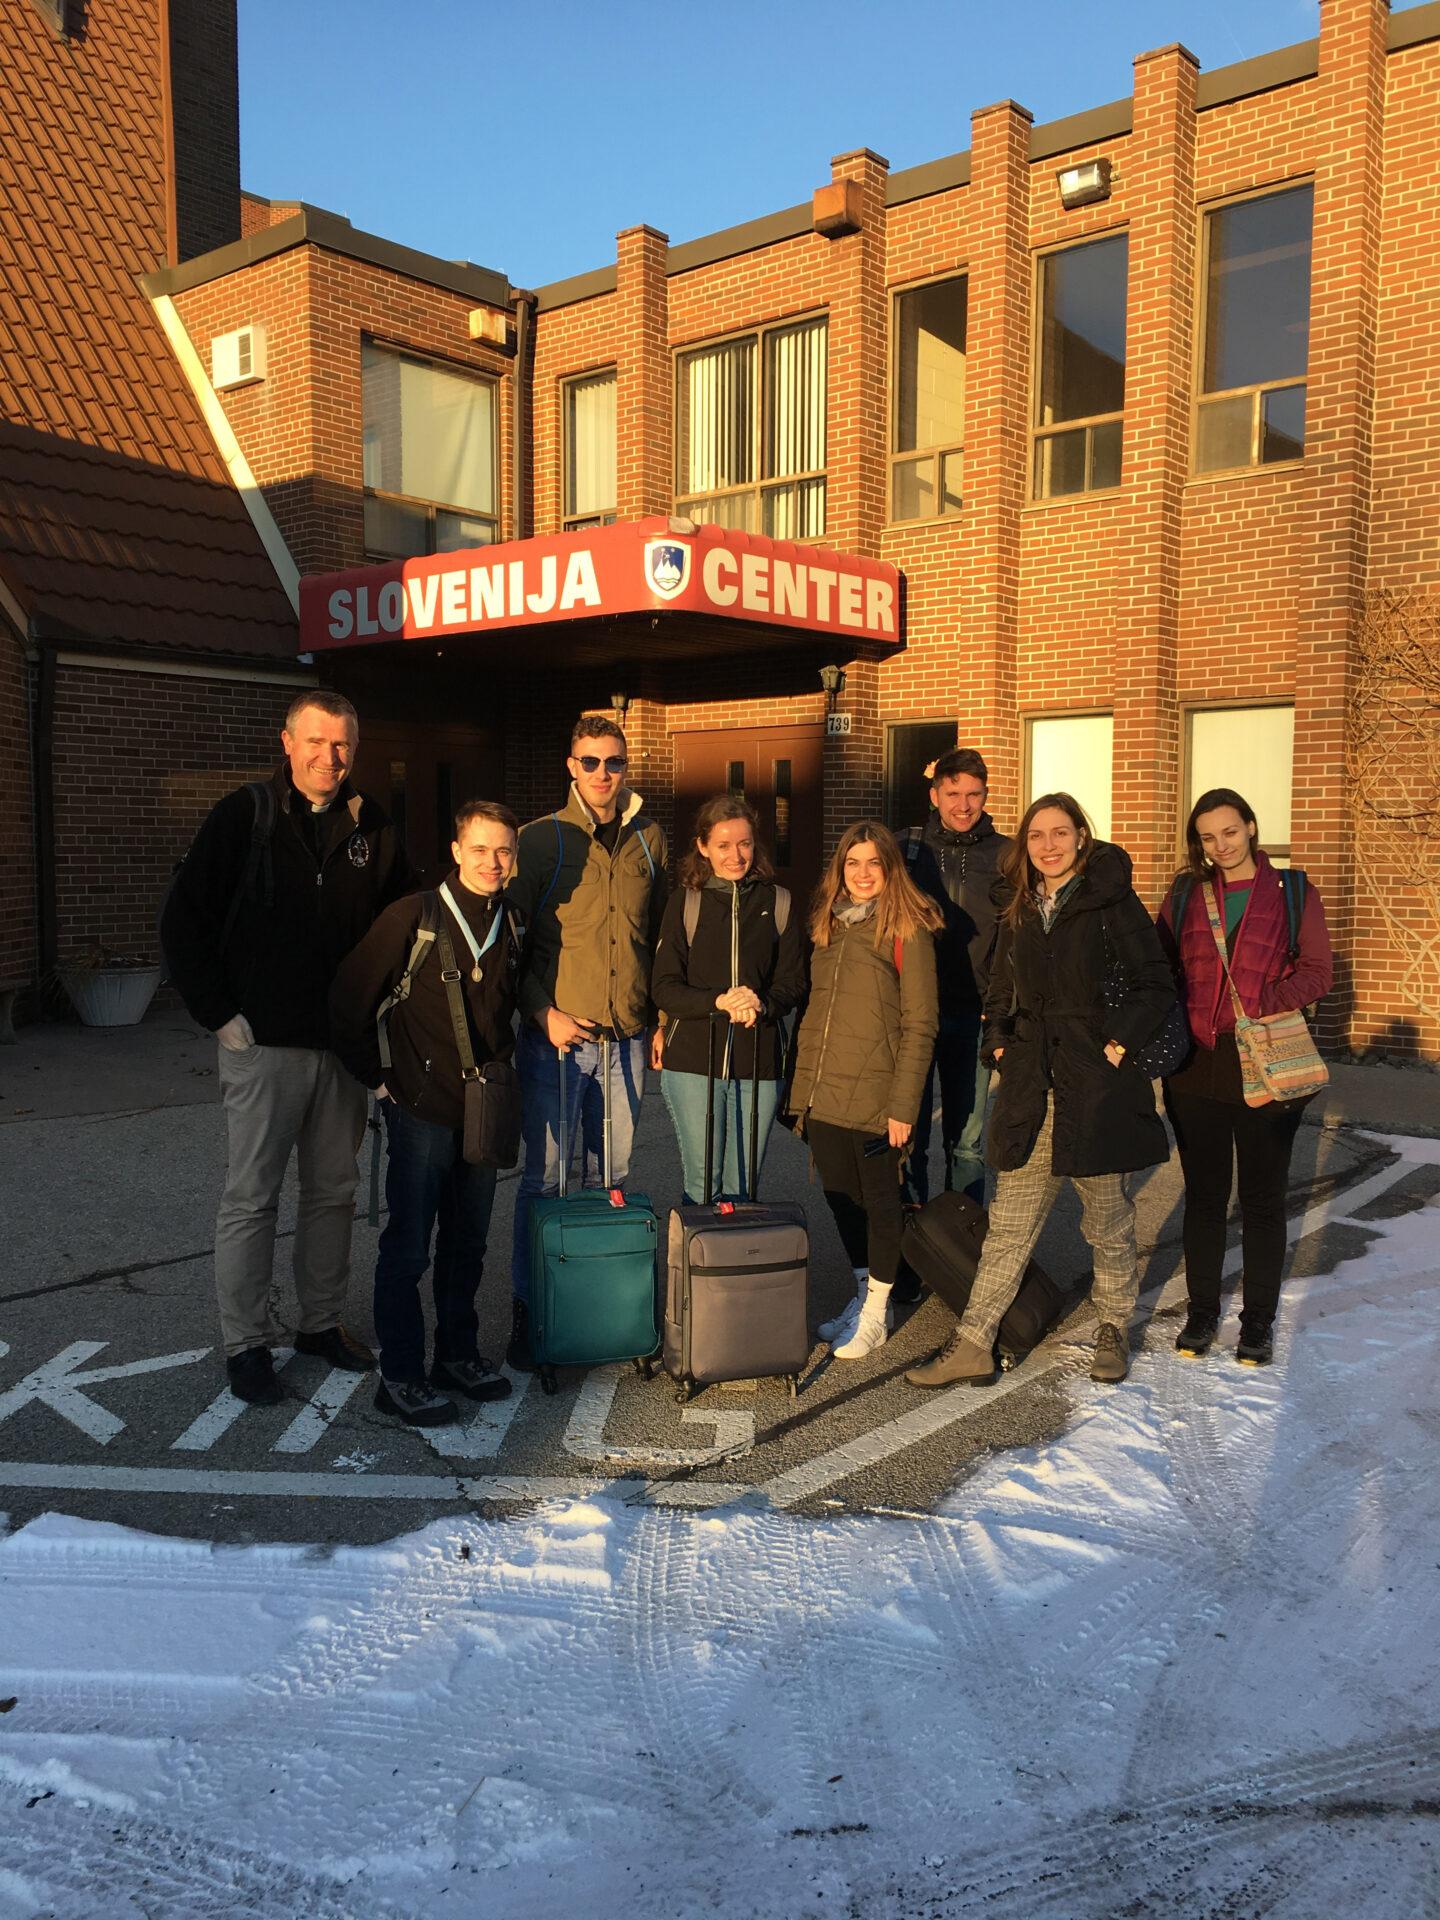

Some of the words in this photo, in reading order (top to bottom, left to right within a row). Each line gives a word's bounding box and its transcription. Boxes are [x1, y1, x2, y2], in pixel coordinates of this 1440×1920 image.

[328, 549, 602, 639] SLOVENIJA
[702, 547, 895, 633] CENTER
[828, 716, 850, 732] 739
